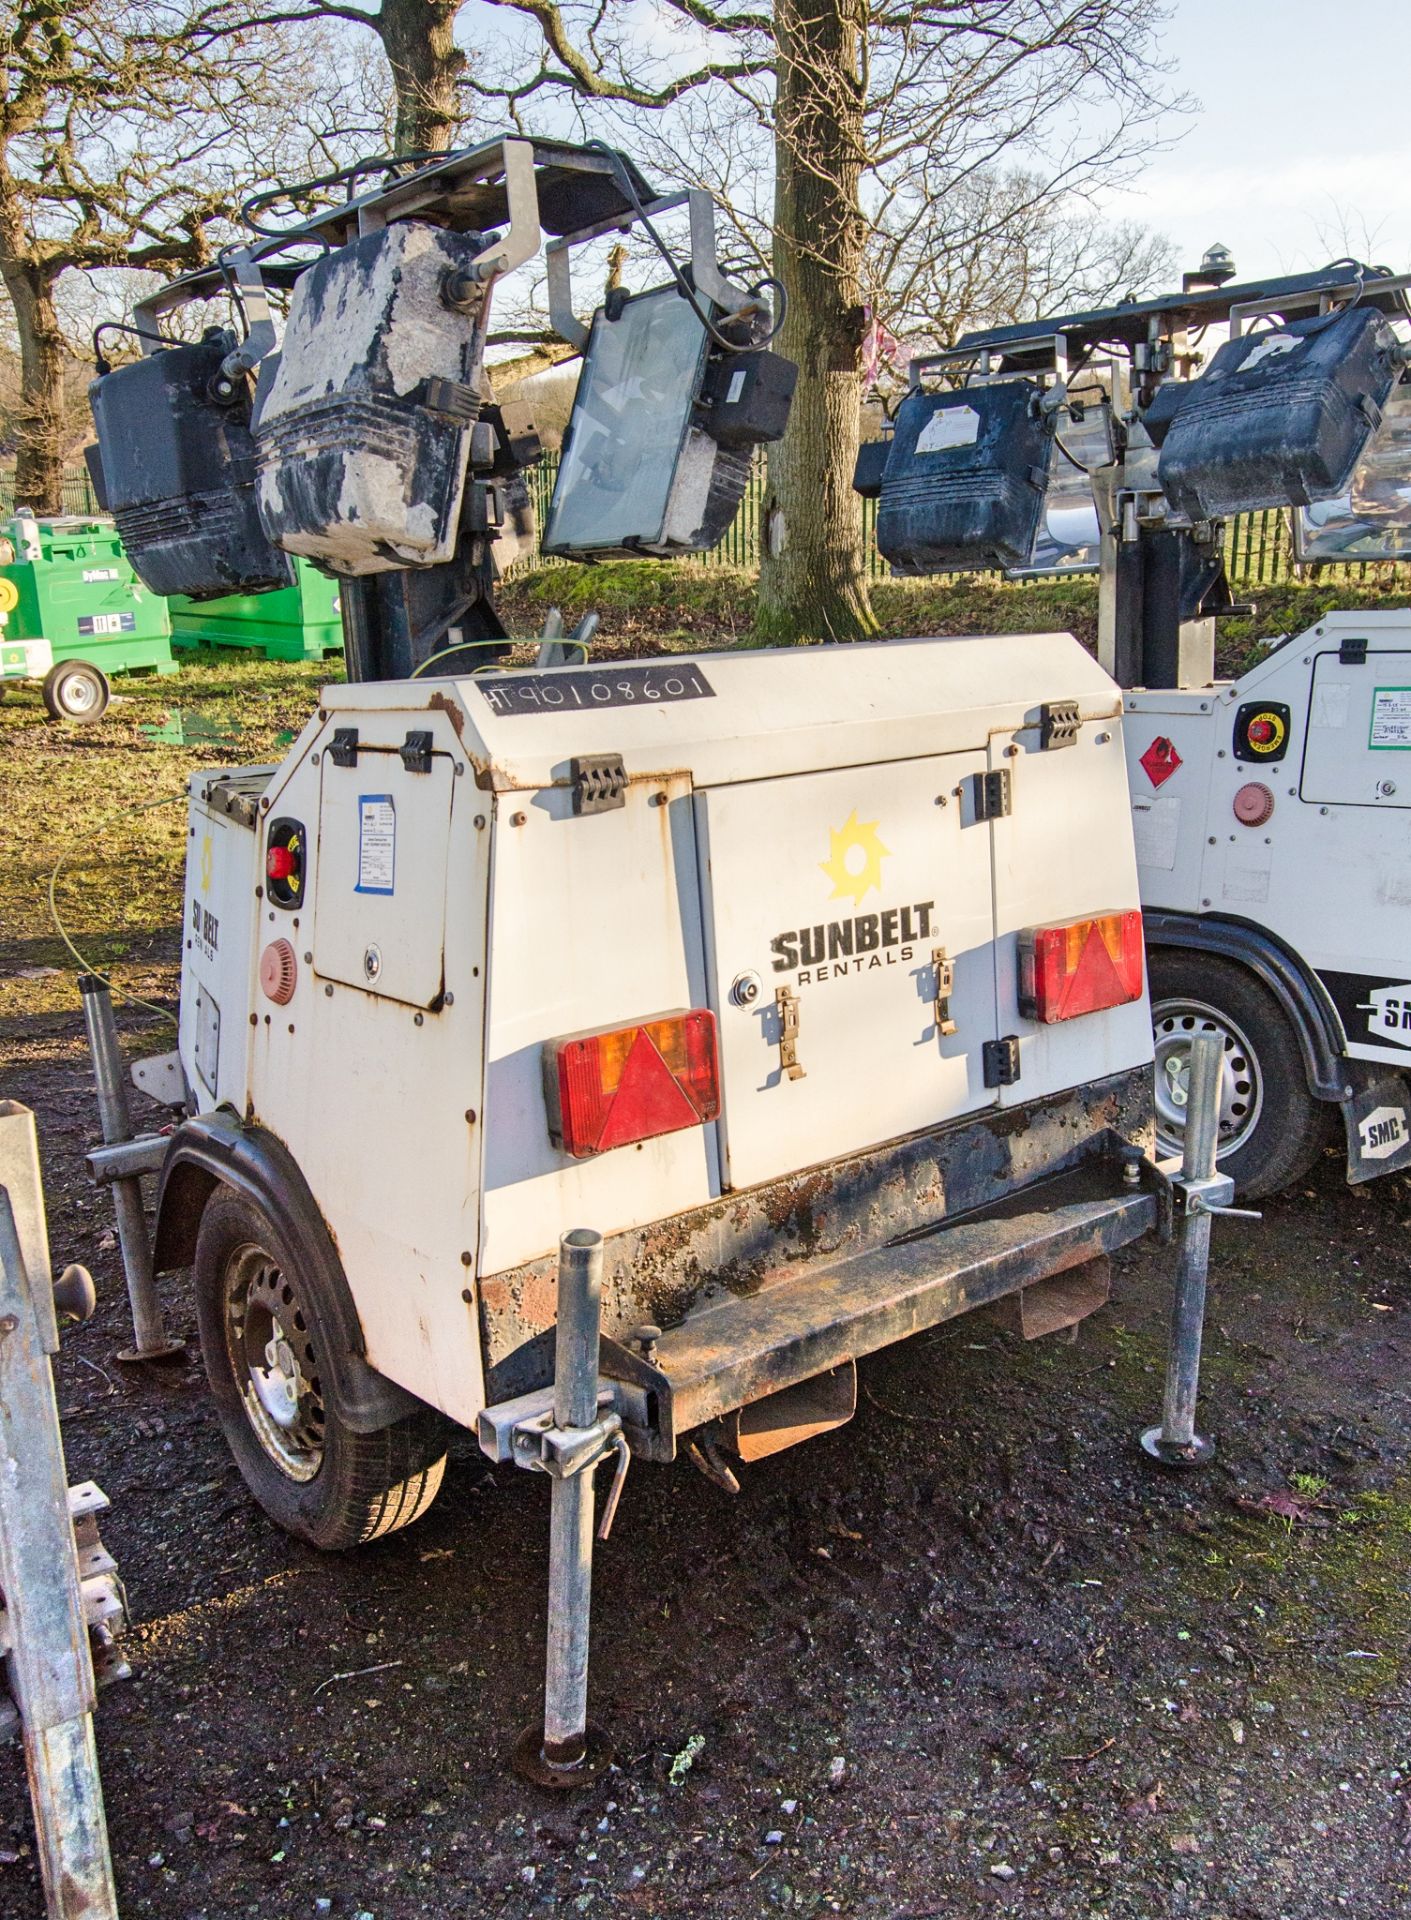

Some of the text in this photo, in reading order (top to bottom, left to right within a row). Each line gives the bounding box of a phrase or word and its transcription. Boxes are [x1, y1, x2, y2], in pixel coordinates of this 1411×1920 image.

[770, 901, 935, 973] SUNBELT
[798, 946, 913, 987] RENTALS
[1368, 1117, 1400, 1149] SMC
